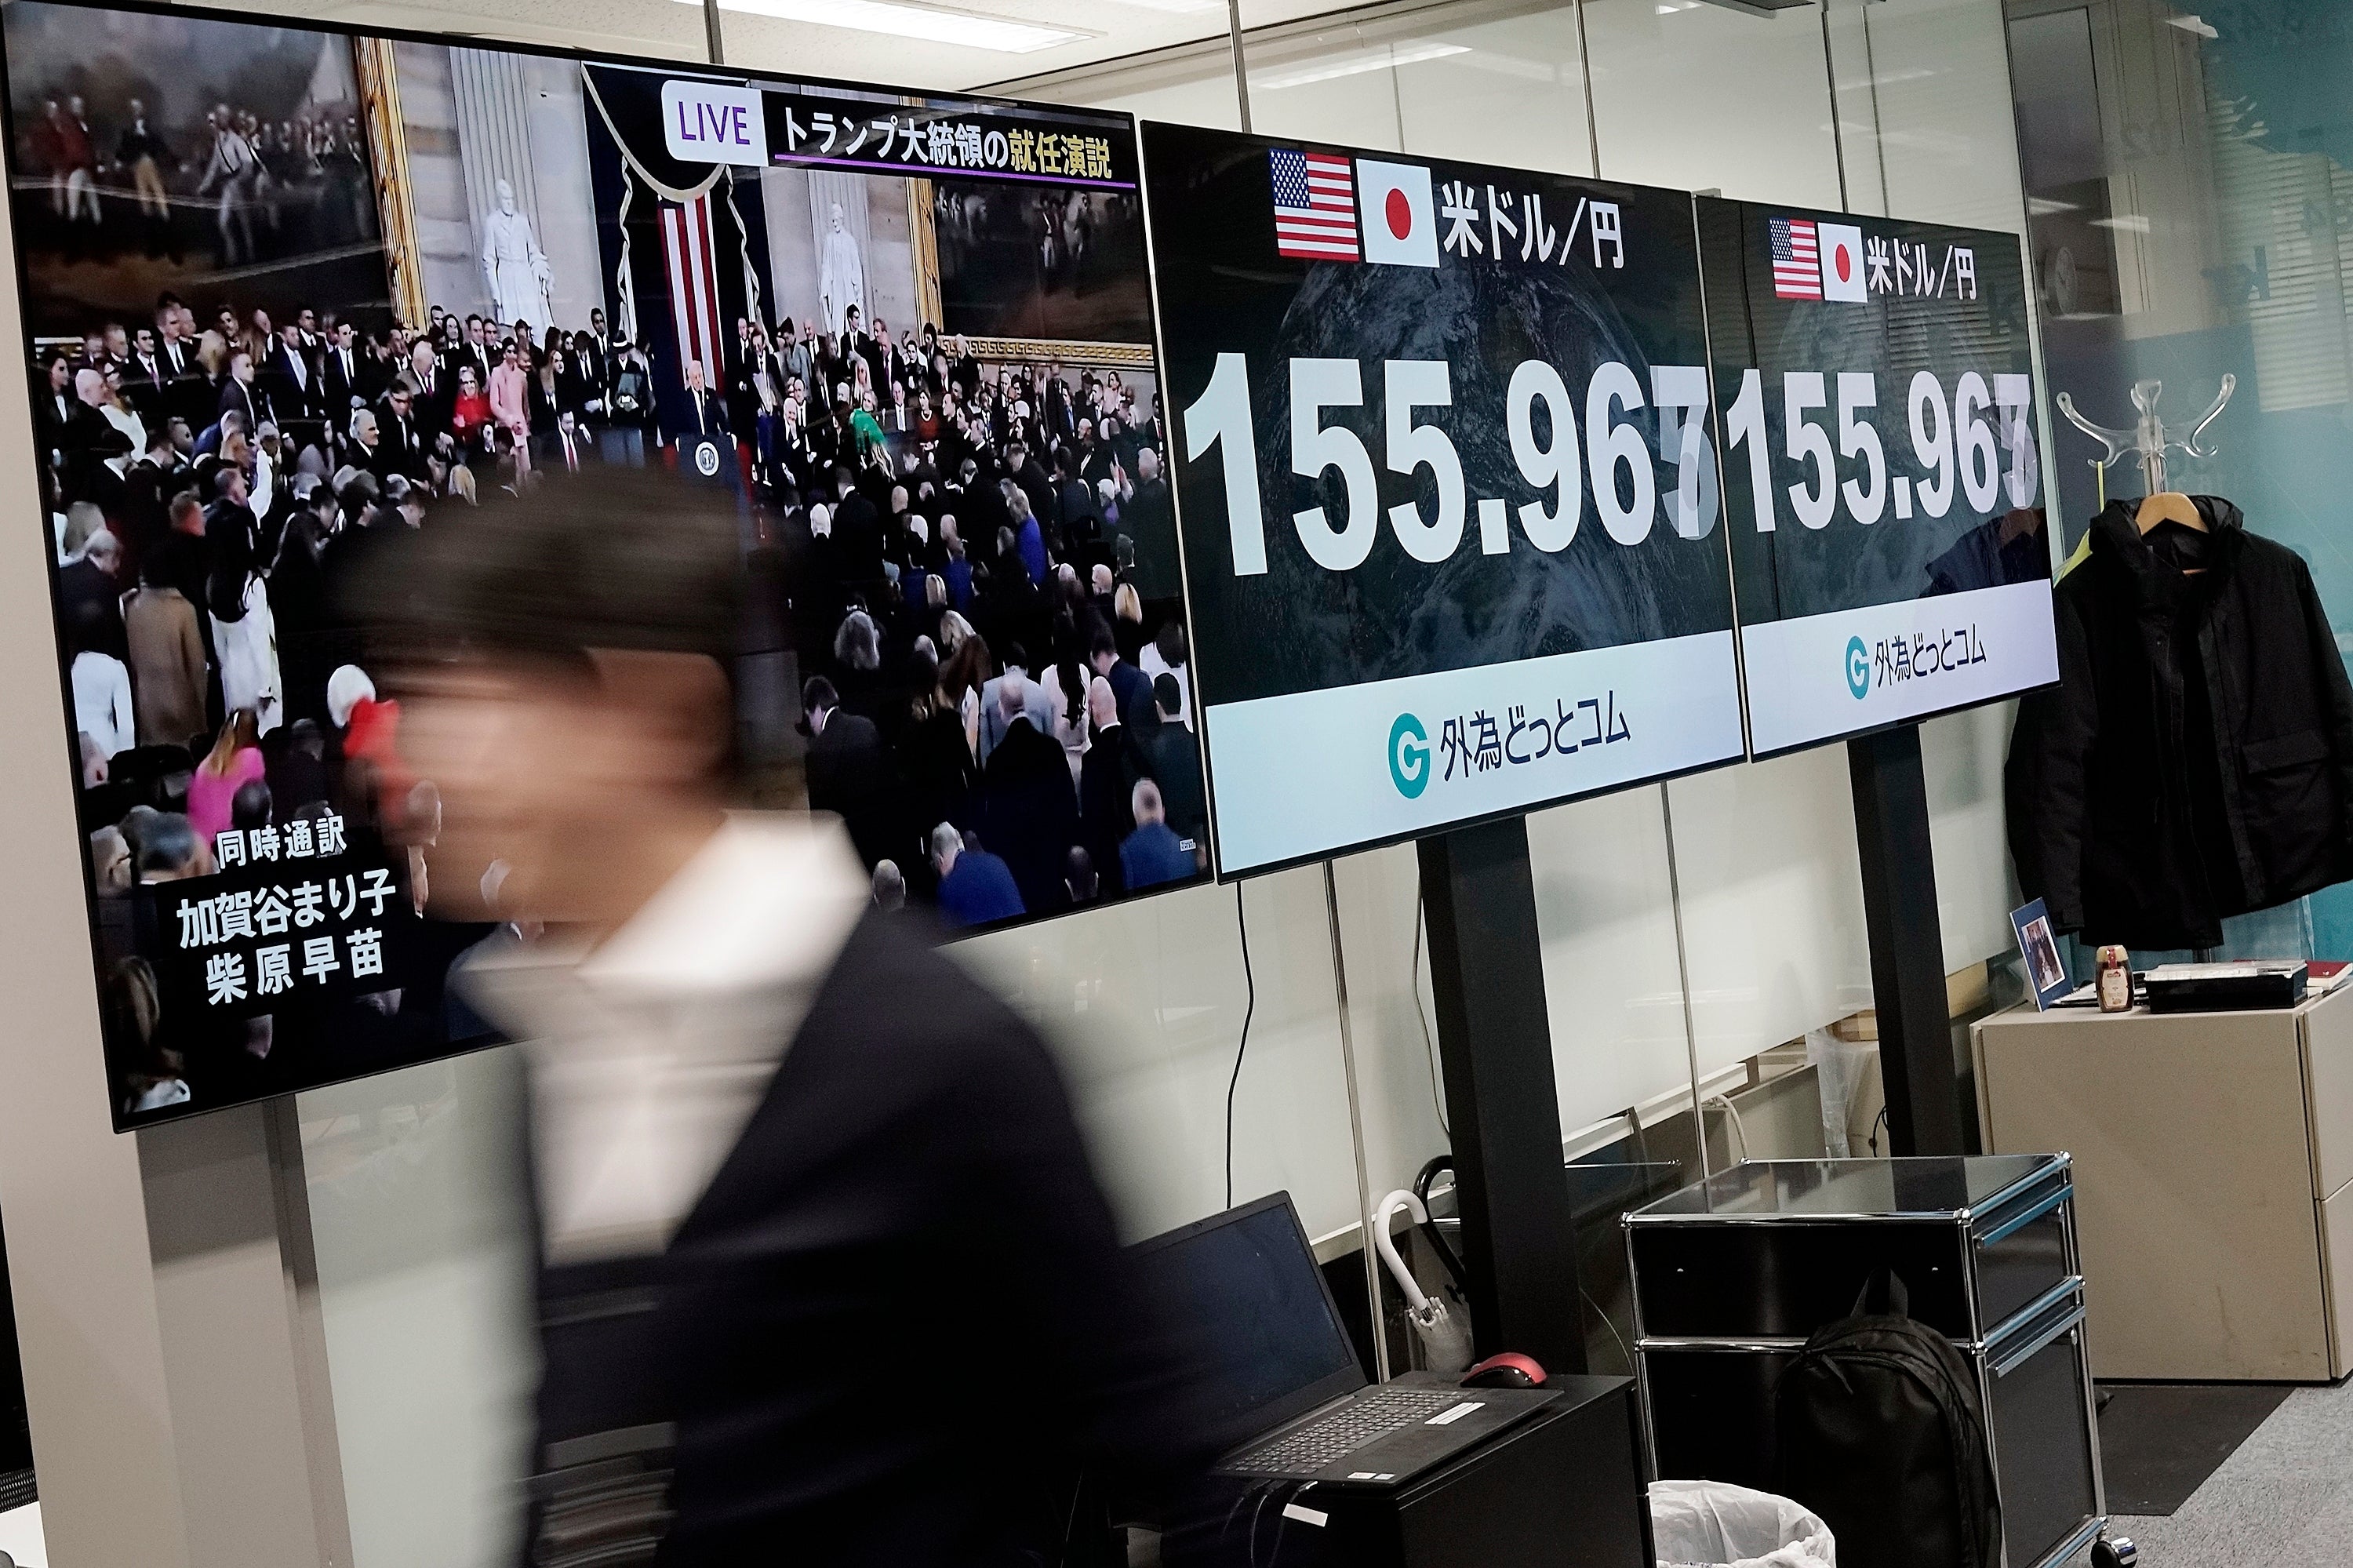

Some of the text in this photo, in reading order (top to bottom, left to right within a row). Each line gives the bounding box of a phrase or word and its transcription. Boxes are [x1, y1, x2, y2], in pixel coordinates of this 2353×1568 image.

[678, 100, 750, 145] LIVE
[785, 106, 1112, 180] トランプ大統領の就任演説
[1875, 624, 1987, 688] 外為どっとコム
[1440, 690, 1631, 782] 外為どっとコム
[216, 815, 347, 869] 同時通訳
[176, 868, 396, 949] 加賀谷まり子
[205, 927, 384, 1006] 柴原早苗
